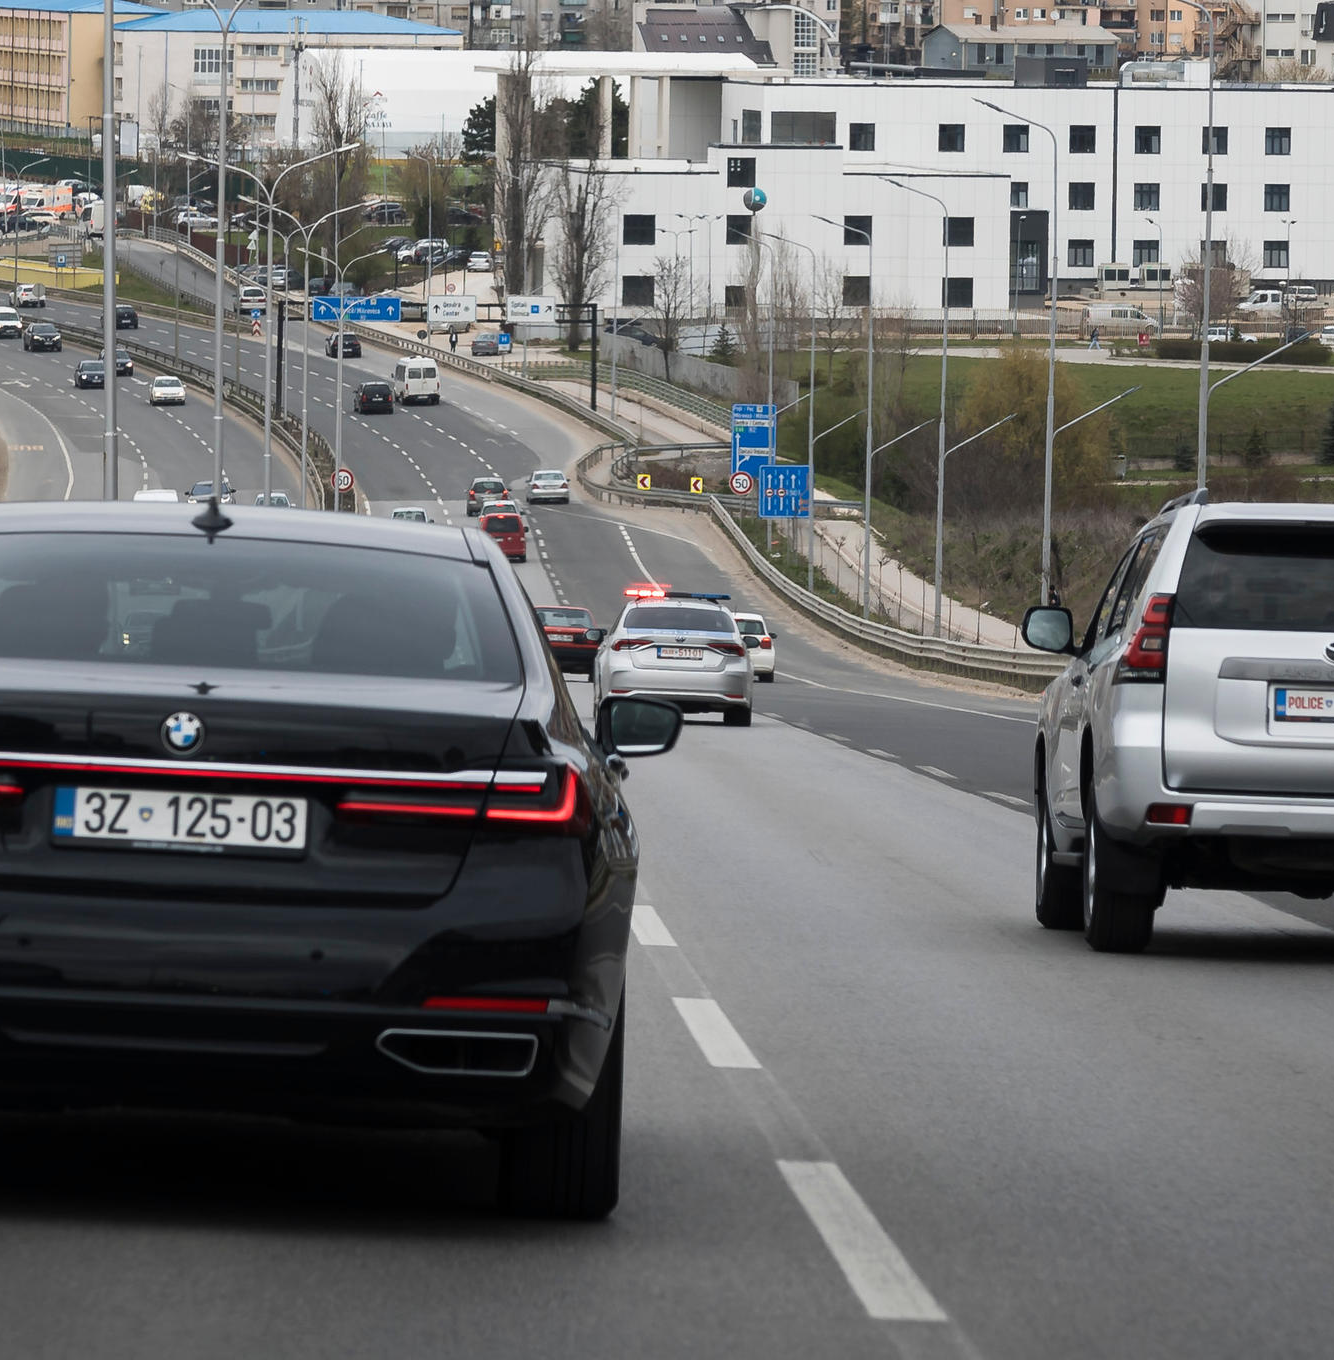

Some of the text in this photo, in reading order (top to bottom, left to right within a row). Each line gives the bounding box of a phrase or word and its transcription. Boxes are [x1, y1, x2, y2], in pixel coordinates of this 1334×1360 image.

[735, 479, 748, 489] 50
[1269, 665, 1318, 679] LAND
[1288, 695, 1324, 709] POLICE
[84, 792, 131, 833] 3Z
[168, 795, 297, 843] 125-03
